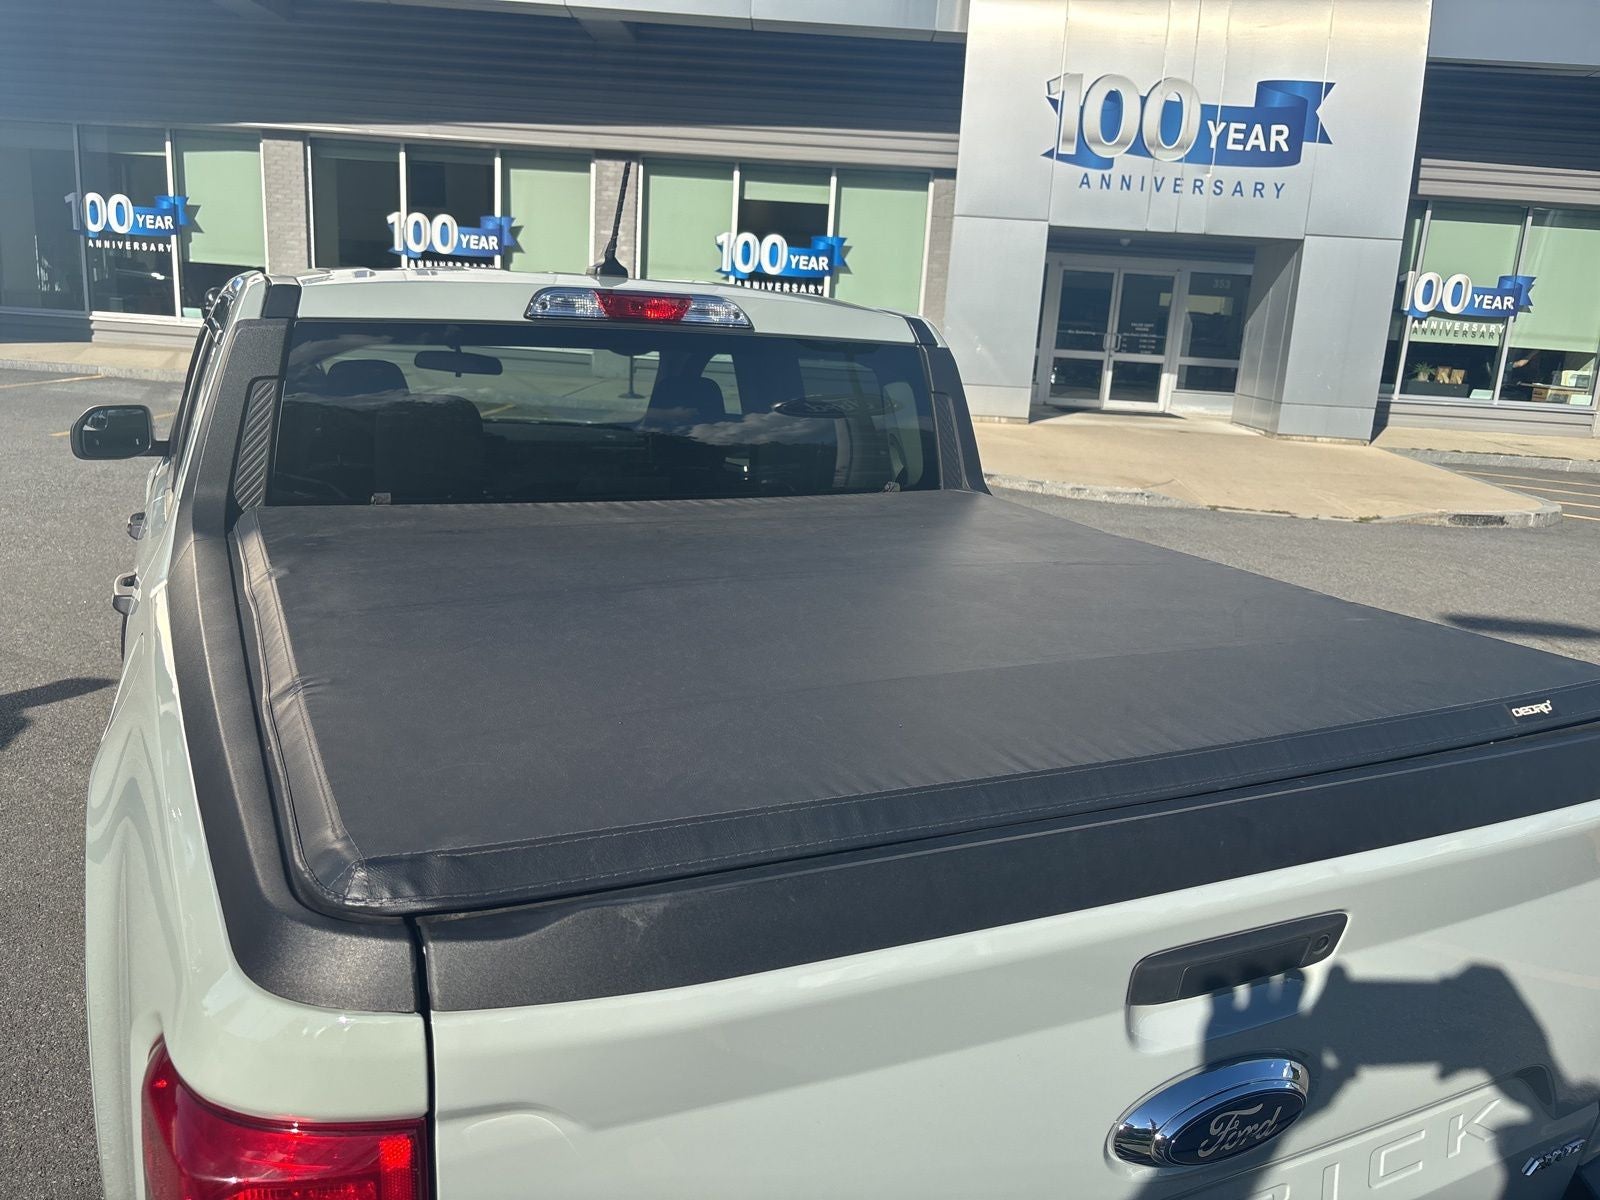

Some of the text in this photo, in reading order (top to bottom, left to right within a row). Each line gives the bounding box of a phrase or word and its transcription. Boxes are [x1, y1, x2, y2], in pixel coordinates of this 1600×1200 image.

[1046, 72, 1290, 162] 100 YEAR
[1079, 172, 1286, 199] ANNIVERSARY
[64, 192, 174, 234] 100 YEAR
[88, 239, 172, 252] ANNIVERSARY
[387, 211, 498, 254] 100 YEAR
[715, 232, 828, 275] 100 YEAR
[736, 280, 824, 294] ANNIVERSARY
[1473, 293, 1514, 310] YEAR
[1412, 319, 1505, 333] ANNIVERSARY
[1198, 1103, 1282, 1157] Ford
